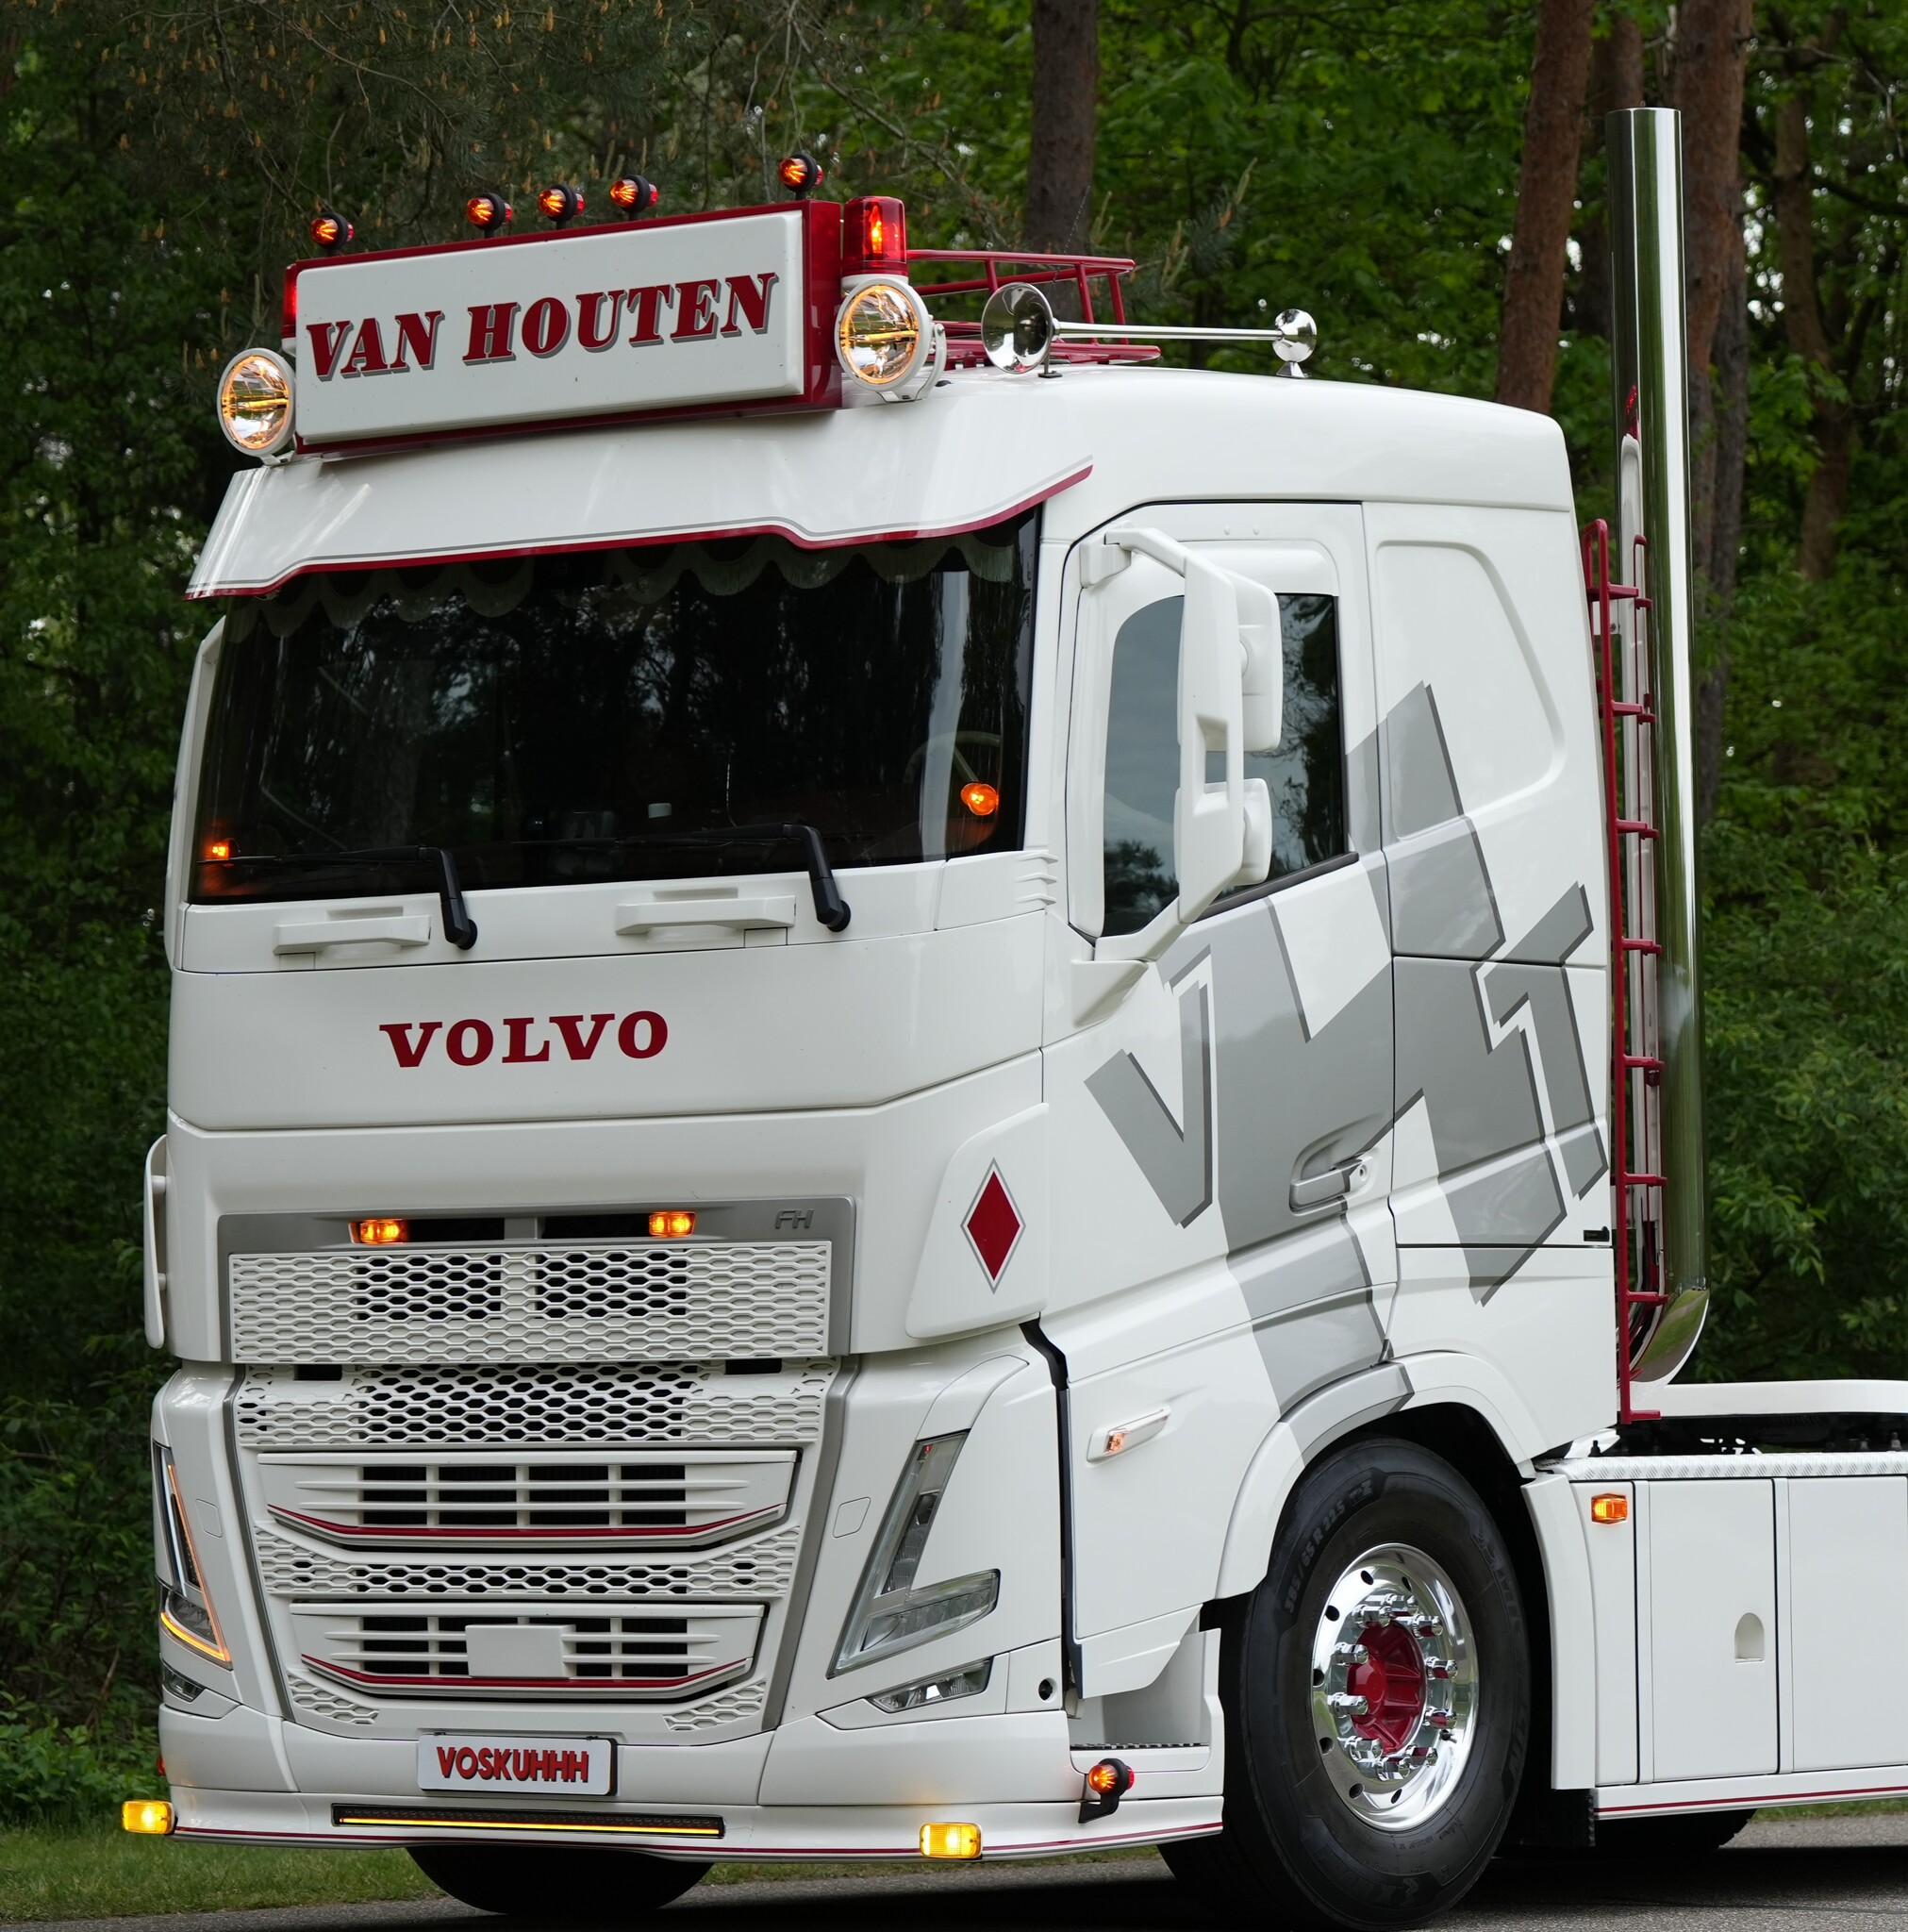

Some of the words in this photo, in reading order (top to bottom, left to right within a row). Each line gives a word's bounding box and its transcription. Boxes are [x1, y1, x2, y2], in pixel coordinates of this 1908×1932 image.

[306, 309, 445, 382] VAN
[461, 272, 779, 366] HOUTEN
[378, 1009, 669, 1068] VOLVO
[774, 1208, 815, 1229] FH
[436, 1745, 589, 1783] VOSKUHHH
